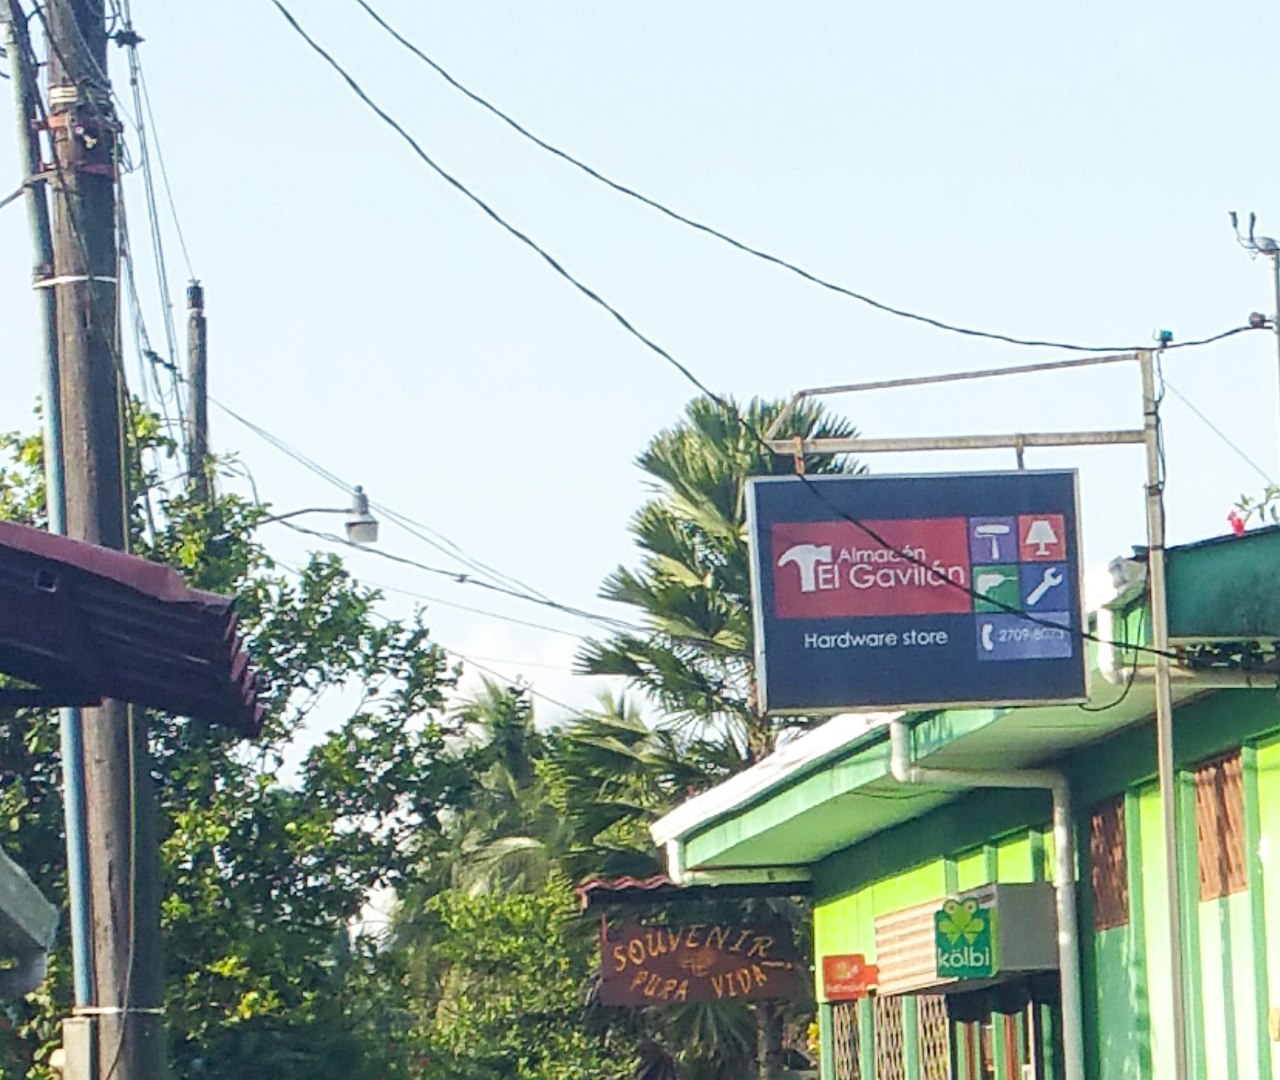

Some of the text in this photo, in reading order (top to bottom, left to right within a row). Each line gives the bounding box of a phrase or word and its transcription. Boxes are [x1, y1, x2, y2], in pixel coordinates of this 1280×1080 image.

[818, 561, 965, 590] El Gavilán
[804, 629, 949, 649] Hardware store
[612, 924, 775, 972] SOUVENIR
[937, 947, 990, 968] kölbi
[711, 964, 767, 999] VIDA
